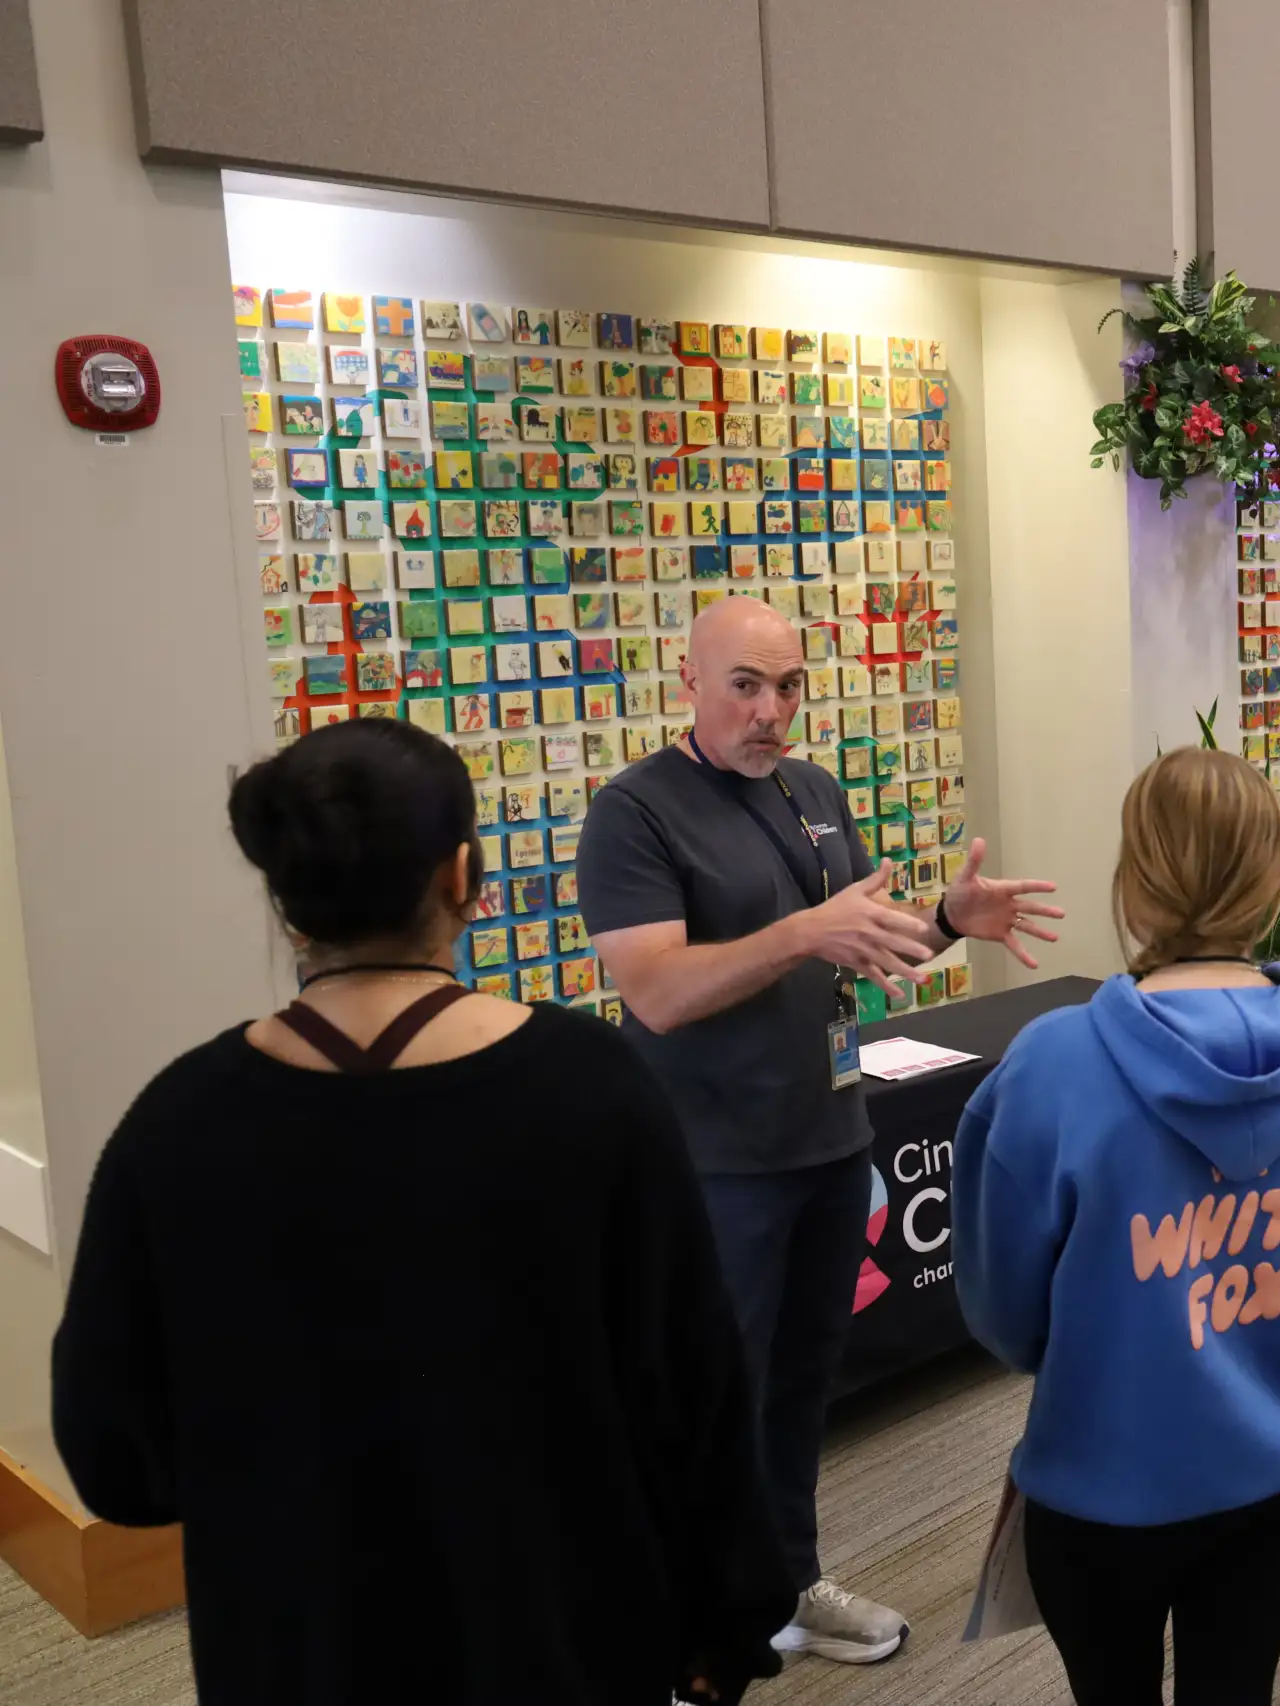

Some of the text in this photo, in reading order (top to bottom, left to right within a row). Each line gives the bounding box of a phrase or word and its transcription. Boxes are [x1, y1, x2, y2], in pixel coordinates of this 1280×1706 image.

[894, 1139, 953, 1183] Cin
[903, 1187, 953, 1253] C
[913, 1261, 954, 1288] char
